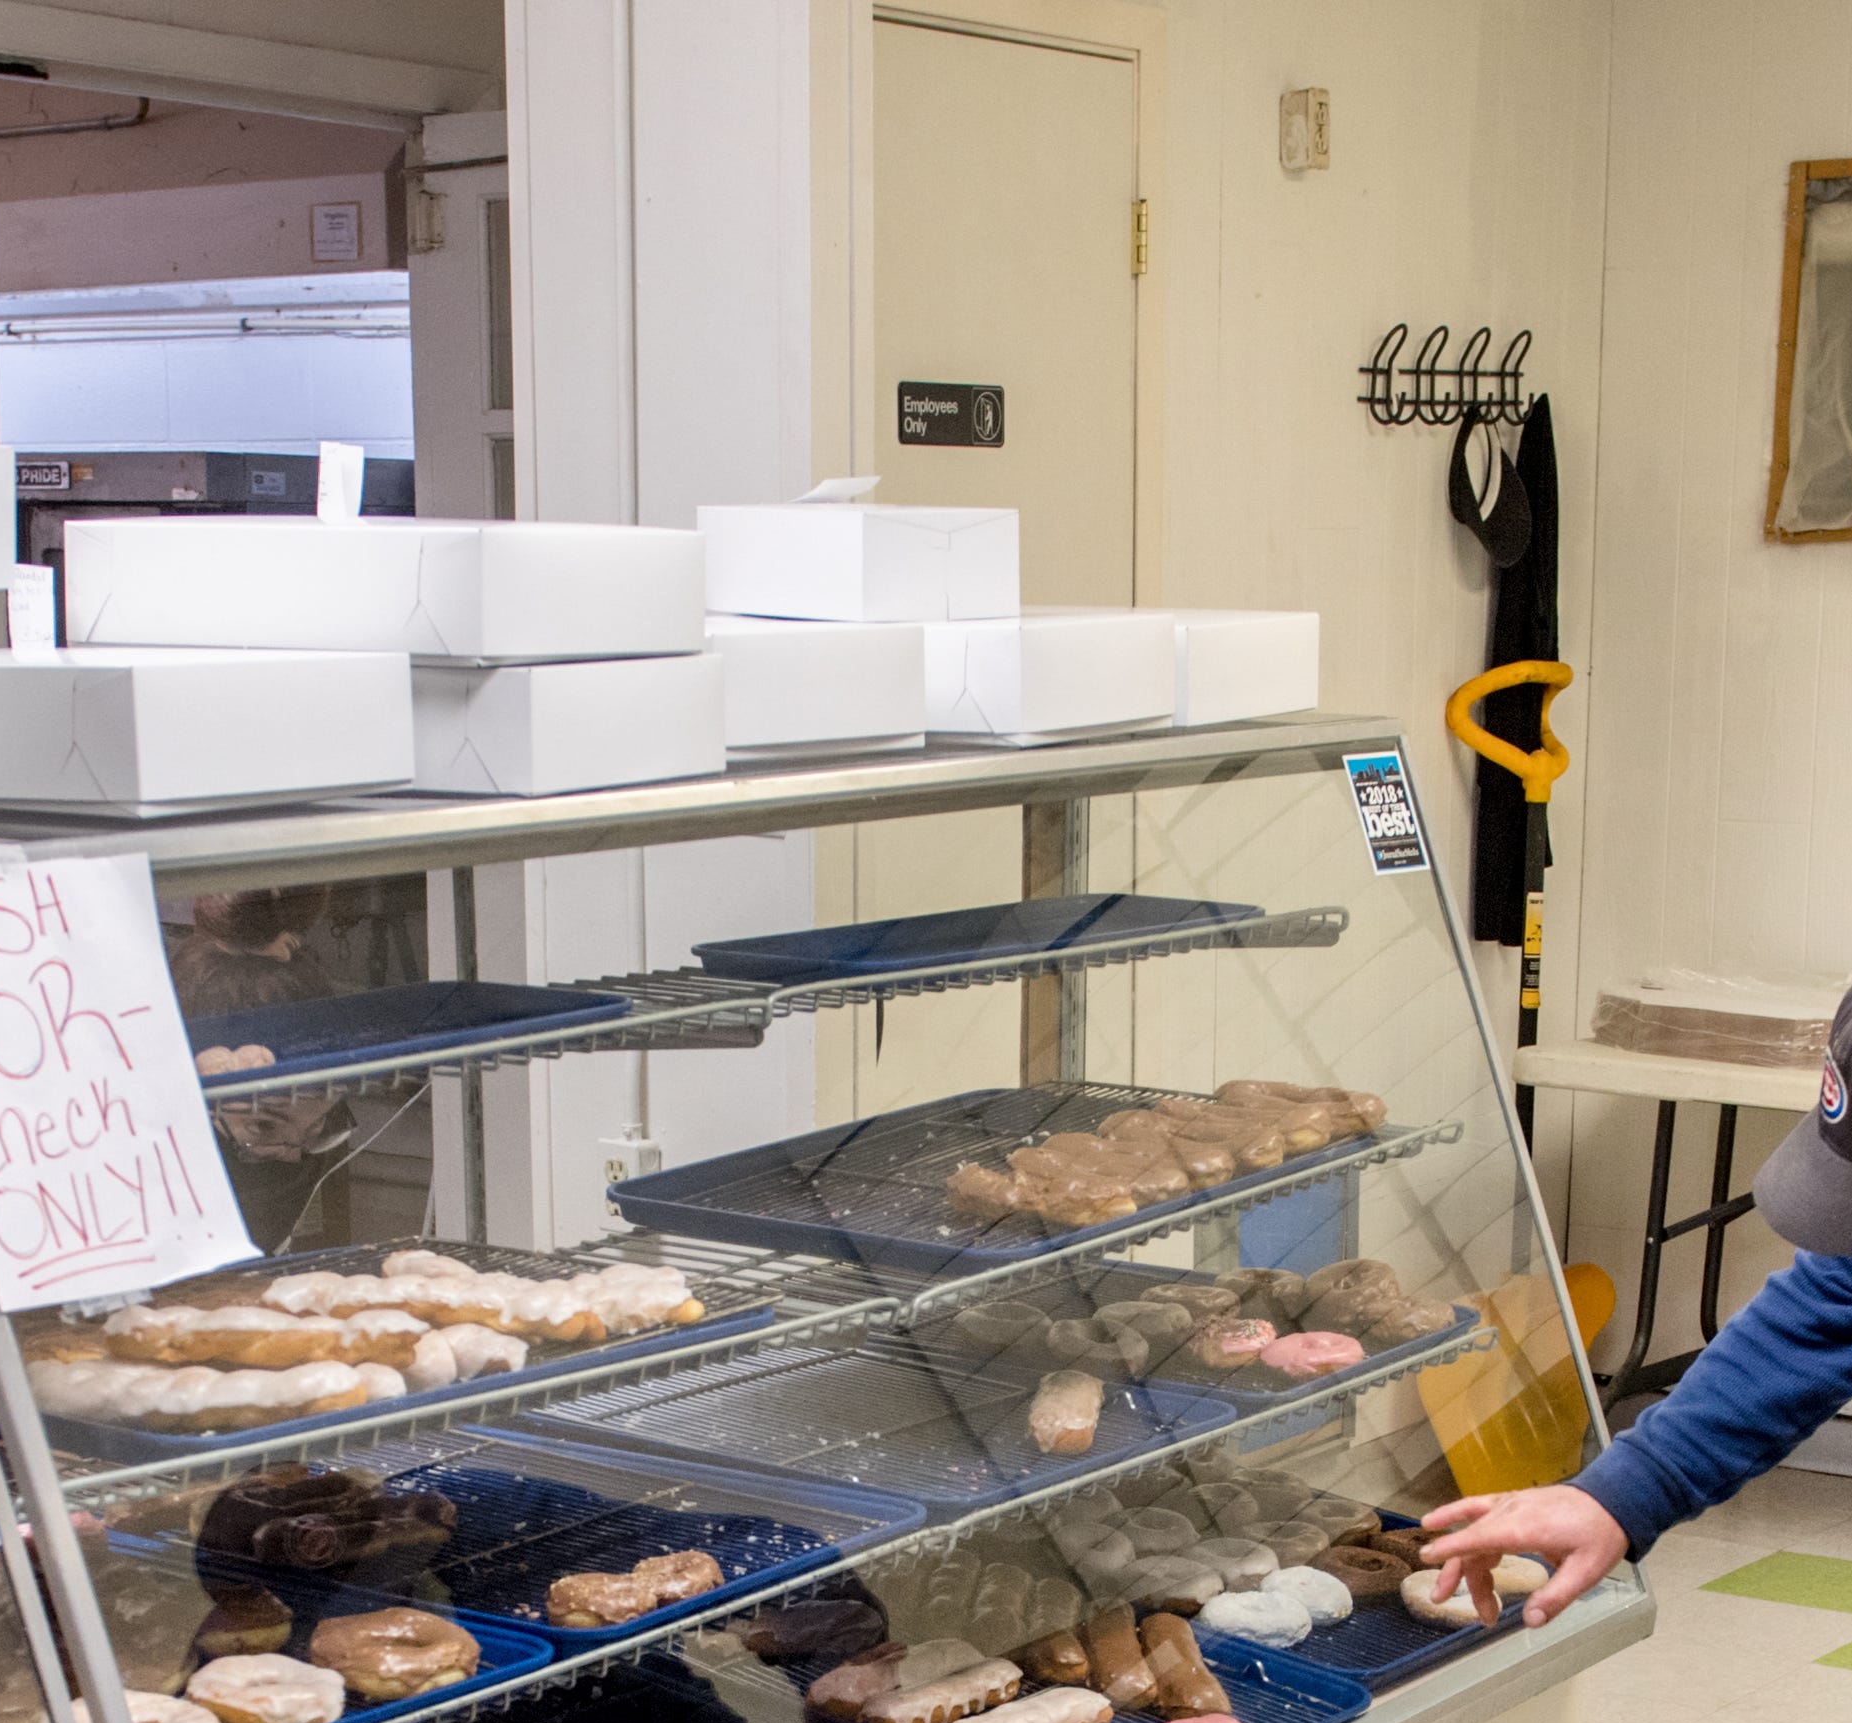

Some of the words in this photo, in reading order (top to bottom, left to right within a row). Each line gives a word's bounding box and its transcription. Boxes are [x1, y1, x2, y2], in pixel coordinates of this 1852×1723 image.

[904, 396, 958, 416] Employees
[904, 417, 927, 437] Only
[21, 468, 60, 483] PRIDE
[1366, 784, 1397, 805] 2018
[1362, 802, 1415, 838] best
